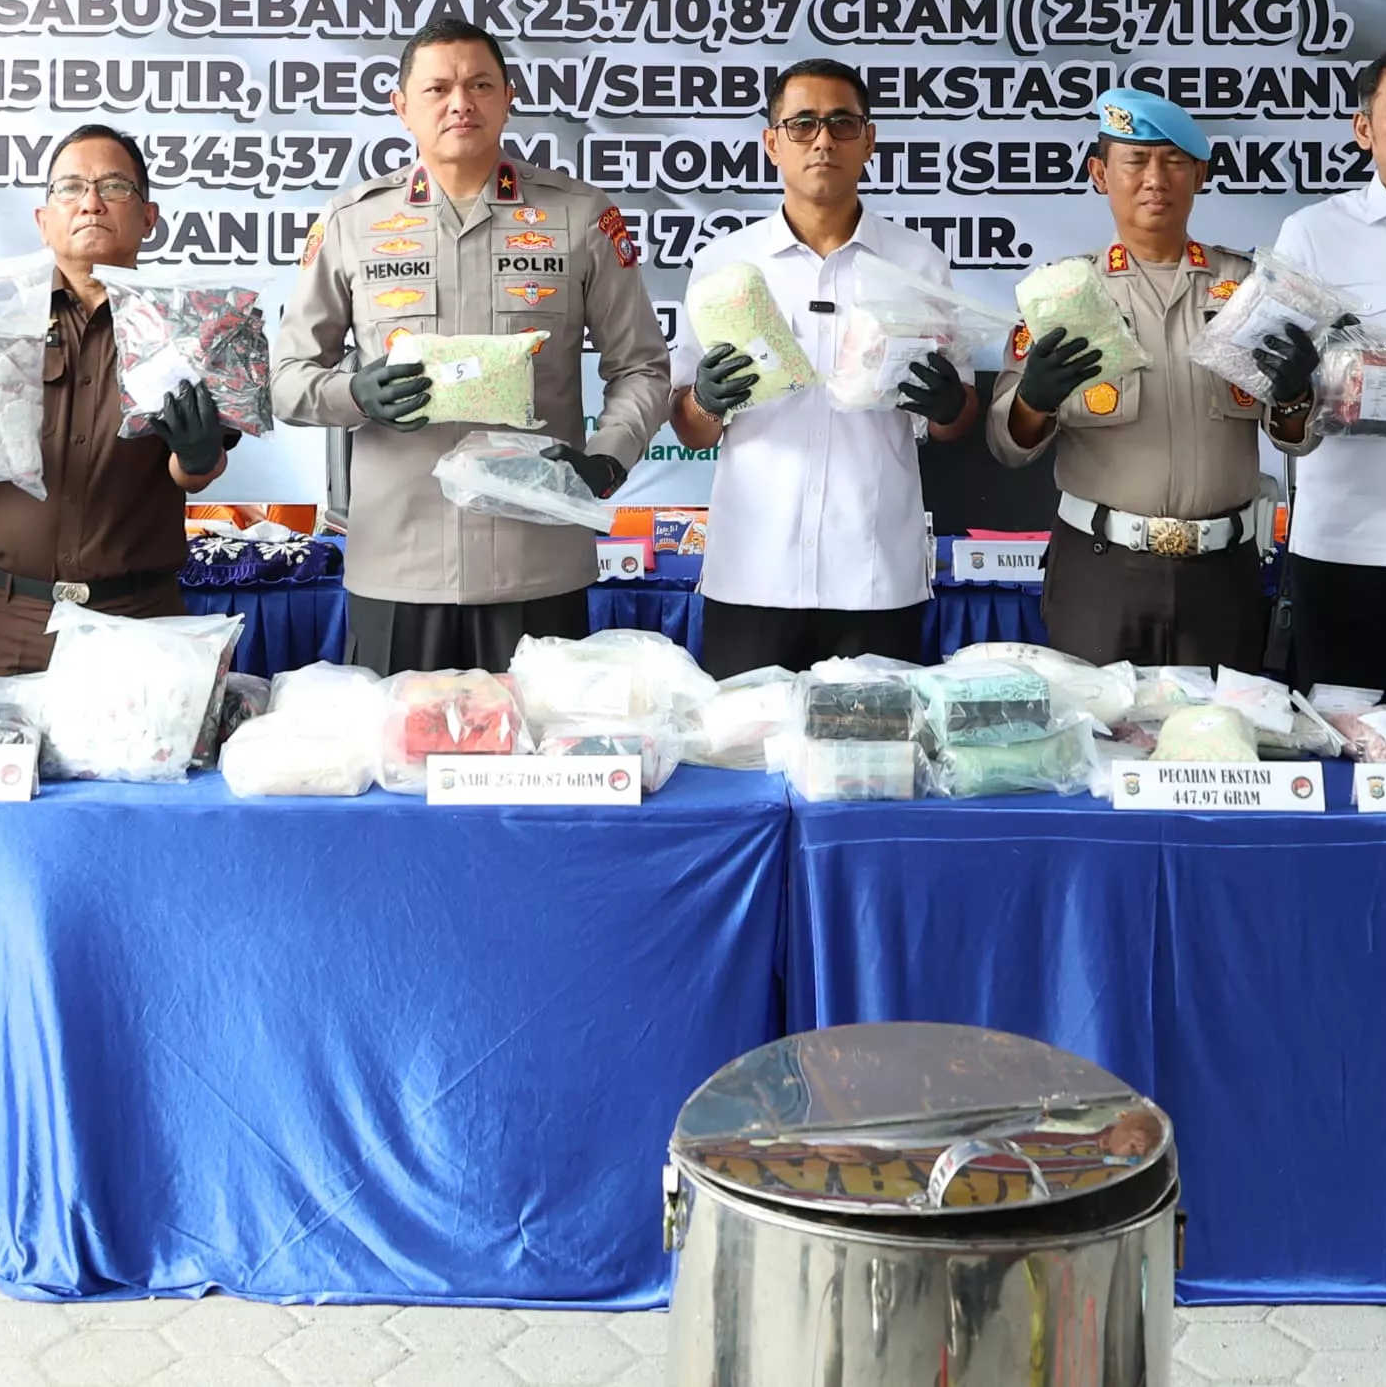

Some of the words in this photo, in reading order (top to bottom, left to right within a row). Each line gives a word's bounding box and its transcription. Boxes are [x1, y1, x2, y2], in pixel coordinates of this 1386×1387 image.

[72, 60, 262, 108] BUTIR,
[283, 61, 779, 108] PECAN/SERB
[1130, 67, 1362, 109] SEBANY
[155, 135, 353, 188] 345,37
[139, 213, 258, 254] DAN
[884, 216, 1033, 259] TIR.
[365, 261, 431, 281] HENGKI
[498, 257, 564, 273] POLRI
[997, 554, 1035, 568] KAJATI
[566, 771, 605, 788] GRAM
[1158, 768, 1217, 784] PECAHAN
[1220, 769, 1272, 785] EKSTASI
[1172, 789, 1219, 805] 447,97
[1223, 790, 1261, 805] GRAM
